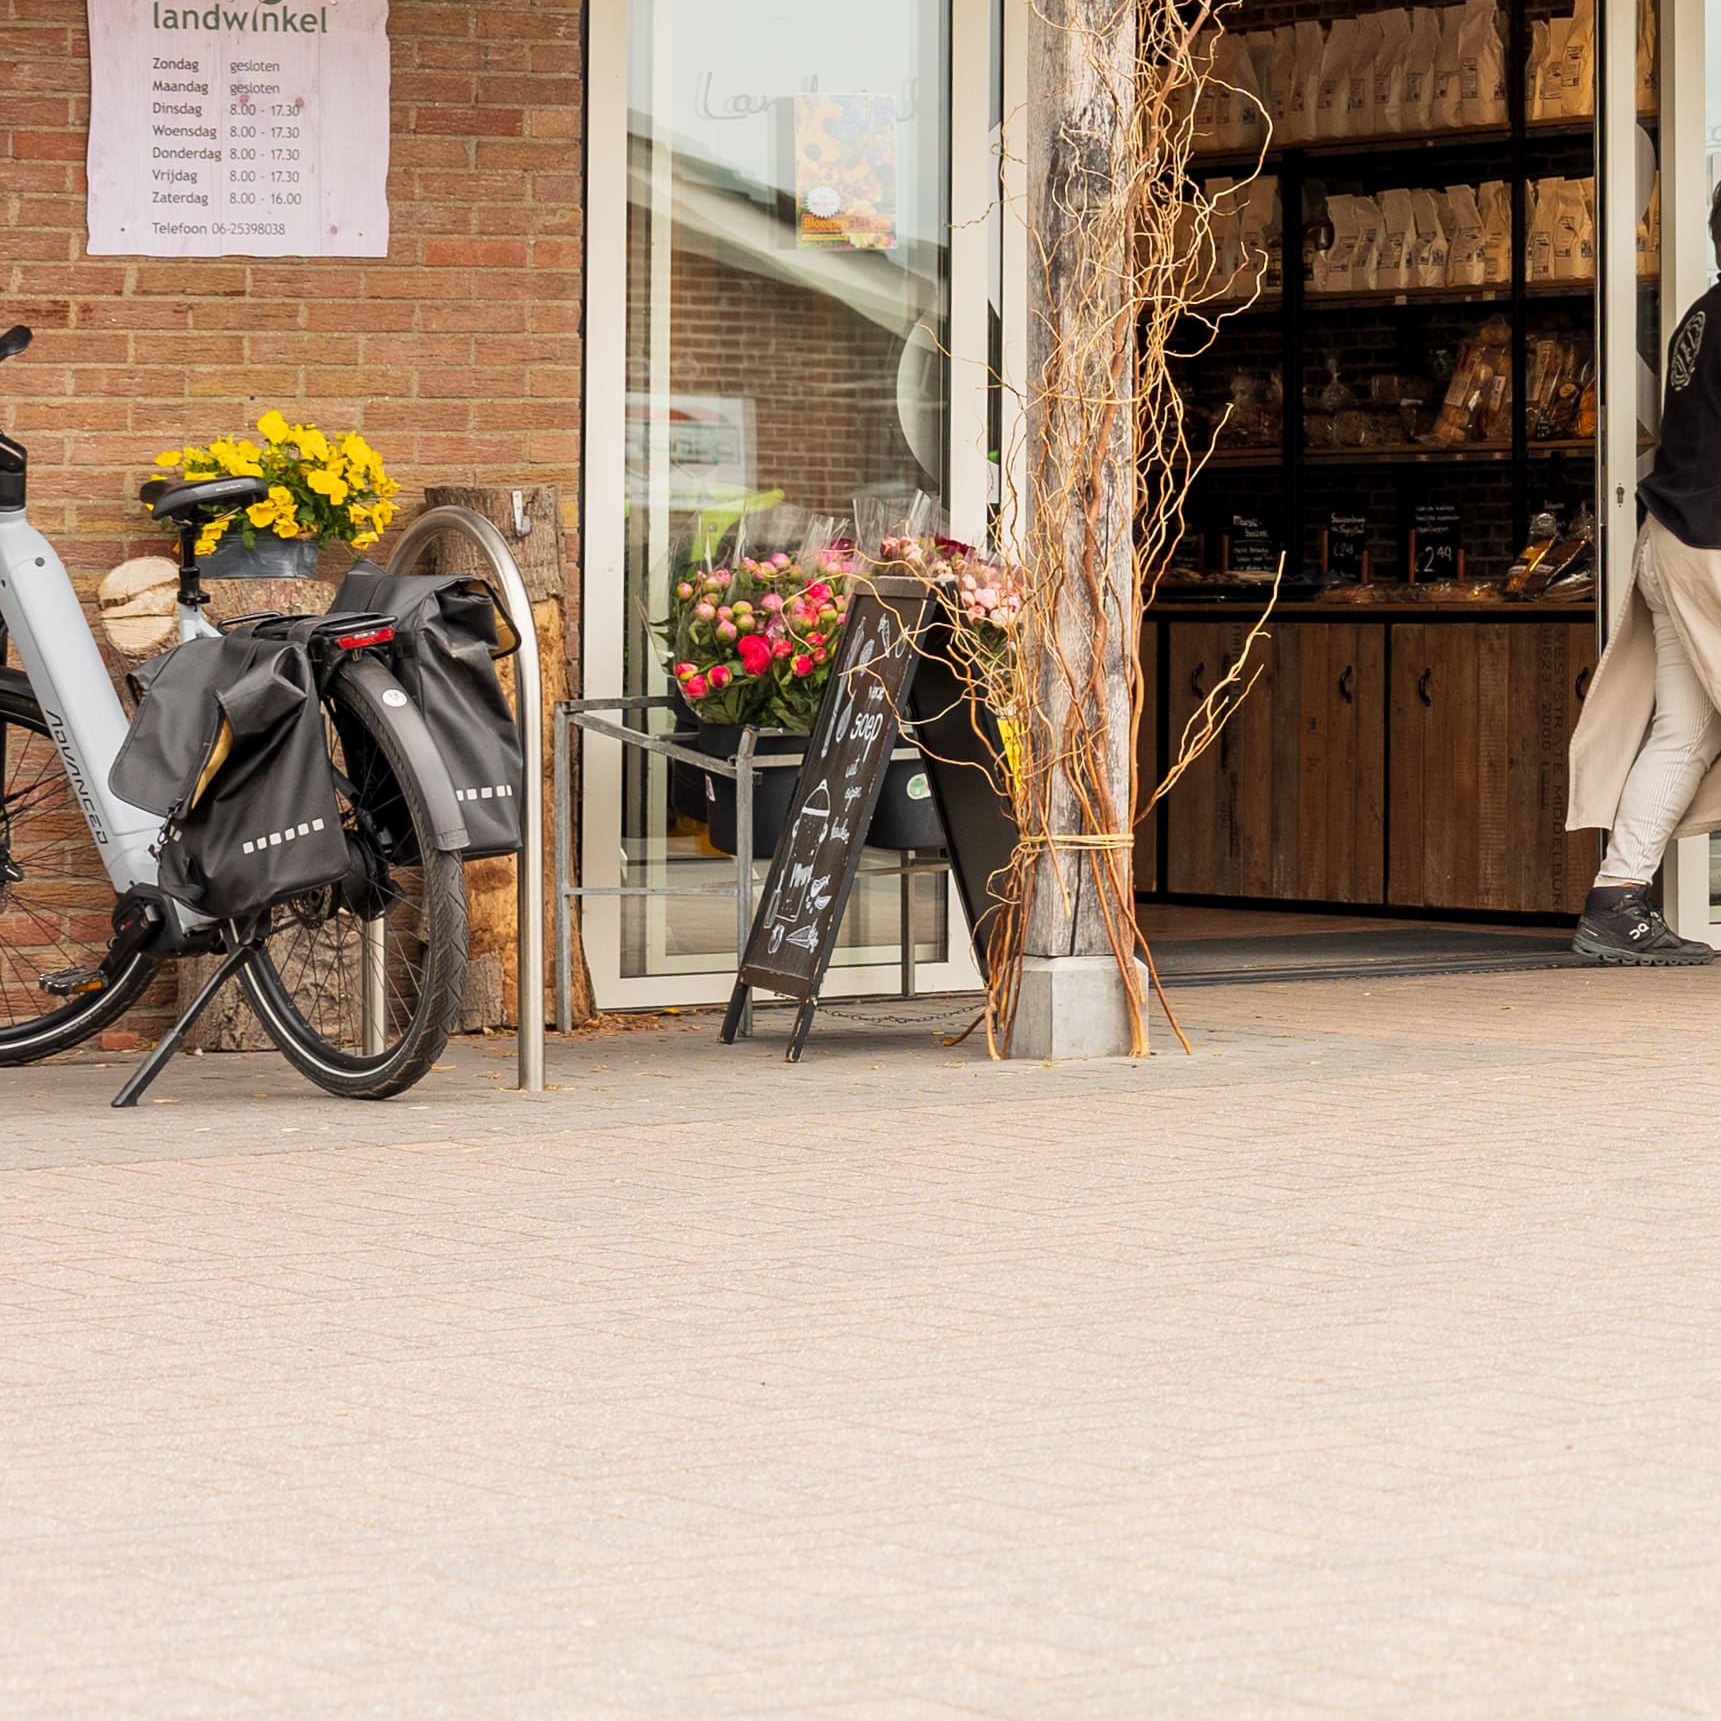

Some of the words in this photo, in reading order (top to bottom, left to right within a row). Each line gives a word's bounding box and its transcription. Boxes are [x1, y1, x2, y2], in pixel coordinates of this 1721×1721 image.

[153, 58, 199, 72] Zondag
[230, 60, 280, 74] gesloten
[152, 81, 209, 95] Maandag
[230, 82, 280, 96] gesloten
[152, 102, 202, 117] Dinsdag
[229, 104, 256, 116] 8.00
[271, 105, 300, 117] 17.30
[152, 125, 217, 139] Woensdag
[229, 126, 256, 138] 8.00
[271, 127, 300, 139] 17.30
[152, 147, 222, 162] Donderdag
[229, 148, 256, 160] 8.00
[271, 149, 300, 161] 17.30
[152, 169, 198, 184] Vrijdag
[229, 170, 256, 182] 8.00
[271, 171, 300, 183] 17.30
[152, 192, 208, 206] Zaterdag
[229, 192, 256, 204] 8.00
[271, 193, 302, 205] 16.00
[152, 222, 207, 235] Telefoon
[212, 223, 286, 235] 06-25398038
[849, 712, 884, 763] soep
[45, 709, 109, 845] ADVANCED
